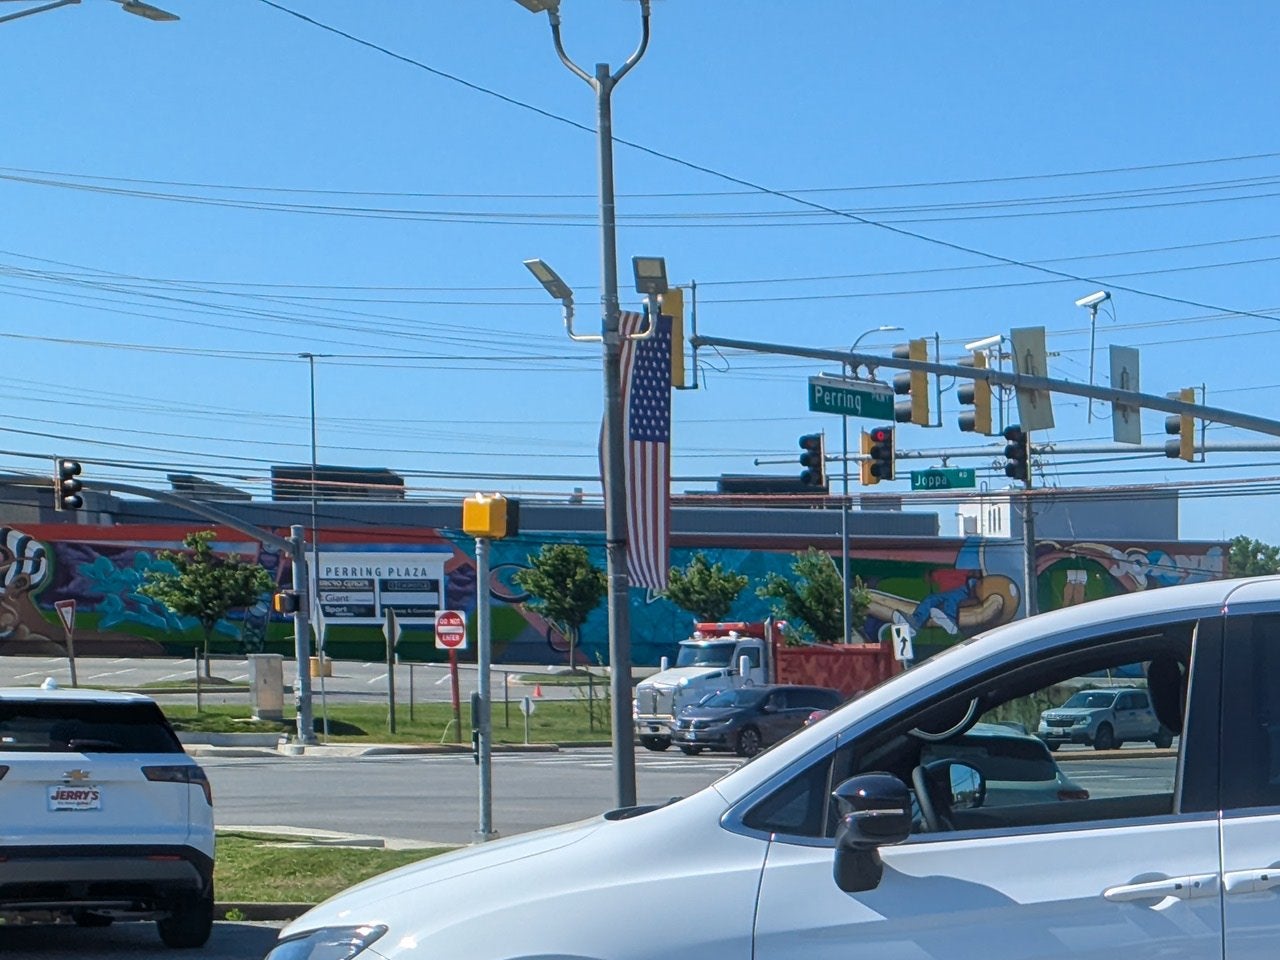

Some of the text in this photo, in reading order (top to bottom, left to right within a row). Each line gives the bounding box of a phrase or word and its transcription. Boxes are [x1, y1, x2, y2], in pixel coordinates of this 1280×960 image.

[814, 385, 862, 414] Perring
[915, 475, 947, 487] Joppa
[325, 566, 427, 577] PERRING PLAZA
[325, 594, 349, 602] Giant
[325, 605, 347, 615] Sport
[51, 790, 99, 800] JERRY'S
